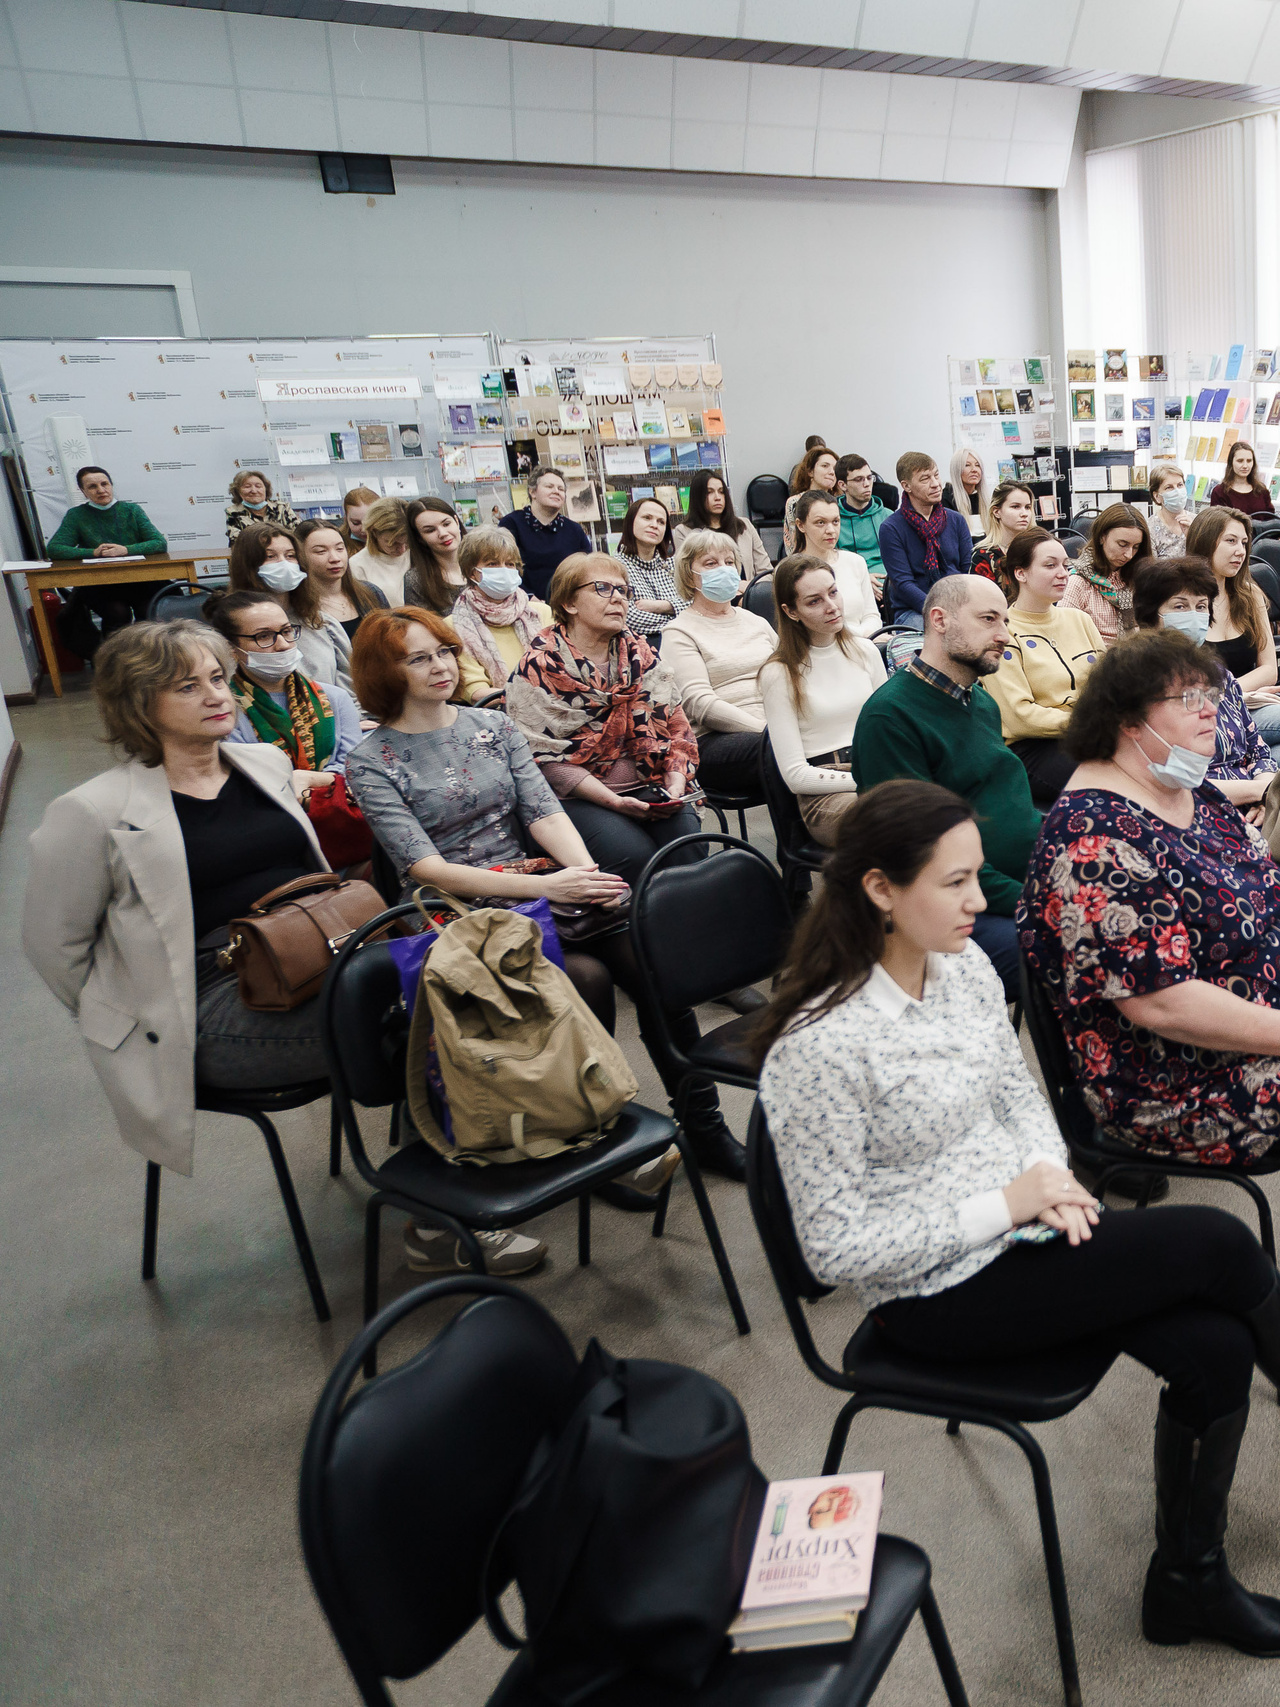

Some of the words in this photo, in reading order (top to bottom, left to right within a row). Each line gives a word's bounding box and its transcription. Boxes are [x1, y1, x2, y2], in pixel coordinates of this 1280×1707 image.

[276, 382, 369, 397] Ярославская
[372, 383, 407, 393] книга
[760, 1534, 862, 1563] Хирург
